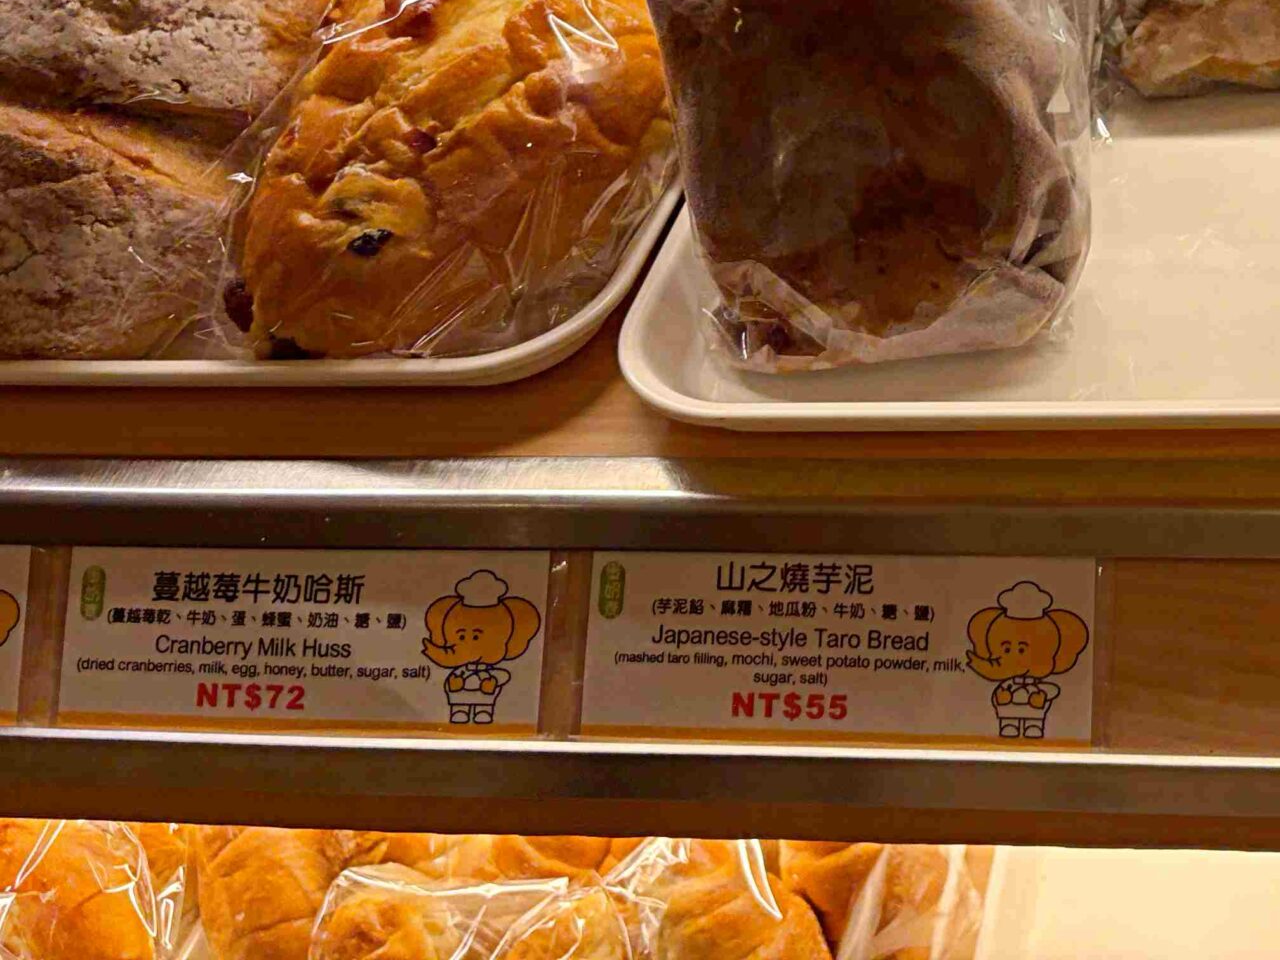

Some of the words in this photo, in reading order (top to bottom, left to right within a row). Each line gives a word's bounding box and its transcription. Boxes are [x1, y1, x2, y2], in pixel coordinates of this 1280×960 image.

[152, 571, 365, 604] 蔓越莓牛奶哈斯
[716, 561, 874, 595] 山之燒芋泥
[155, 634, 253, 660] Cranberry
[258, 637, 296, 657] Milk
[303, 638, 352, 658] Huss
[652, 624, 807, 651] Japanese-style
[814, 628, 861, 649] Taro
[867, 630, 929, 651] Bread
[77, 657, 115, 672] (dried
[118, 658, 195, 675] cranberries,
[199, 661, 228, 675] milk,
[232, 663, 260, 678] egg,
[264, 663, 307, 678] honey,
[311, 663, 353, 679] butter,
[357, 665, 398, 681] sugar,
[402, 665, 431, 681] salt)
[614, 651, 664, 665] (mashed
[668, 653, 690, 664] taro
[694, 652, 727, 667] filling,
[732, 653, 777, 667] mochi,
[782, 655, 822, 667] sweet
[826, 656, 870, 670] potato
[874, 657, 929, 672] powder,
[933, 658, 966, 672] milk,
[753, 672, 796, 686] sugar,
[800, 672, 828, 687] salt)
[196, 682, 305, 711] NT$72
[731, 692, 848, 721] NT$55
